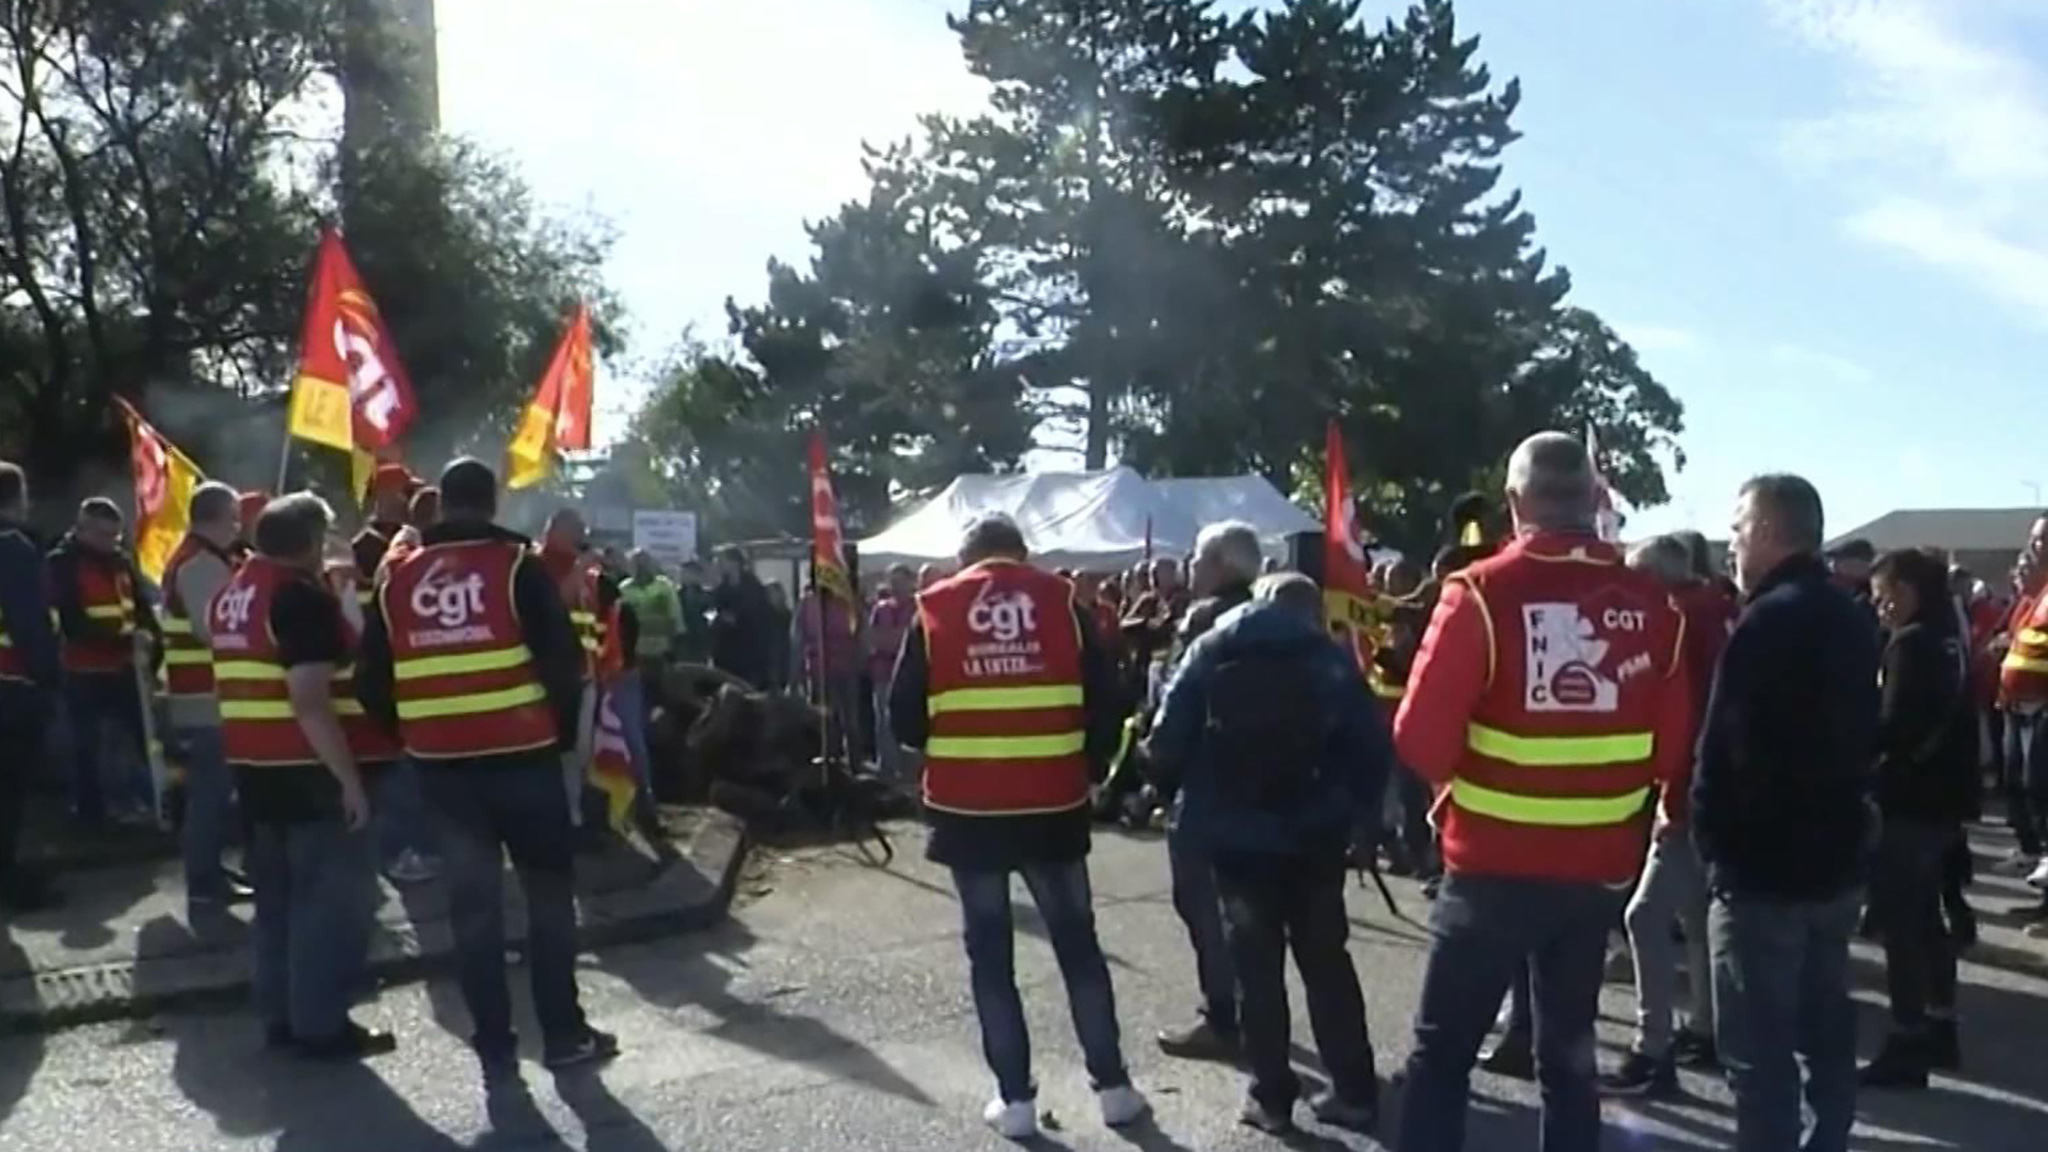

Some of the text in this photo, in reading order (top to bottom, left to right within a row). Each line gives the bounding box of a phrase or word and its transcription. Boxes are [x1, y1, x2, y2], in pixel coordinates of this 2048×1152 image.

[216, 584, 256, 631] cgt
[411, 569, 485, 627] cgt
[968, 586, 1036, 641] cgt
[1603, 608, 1647, 632] CGT
